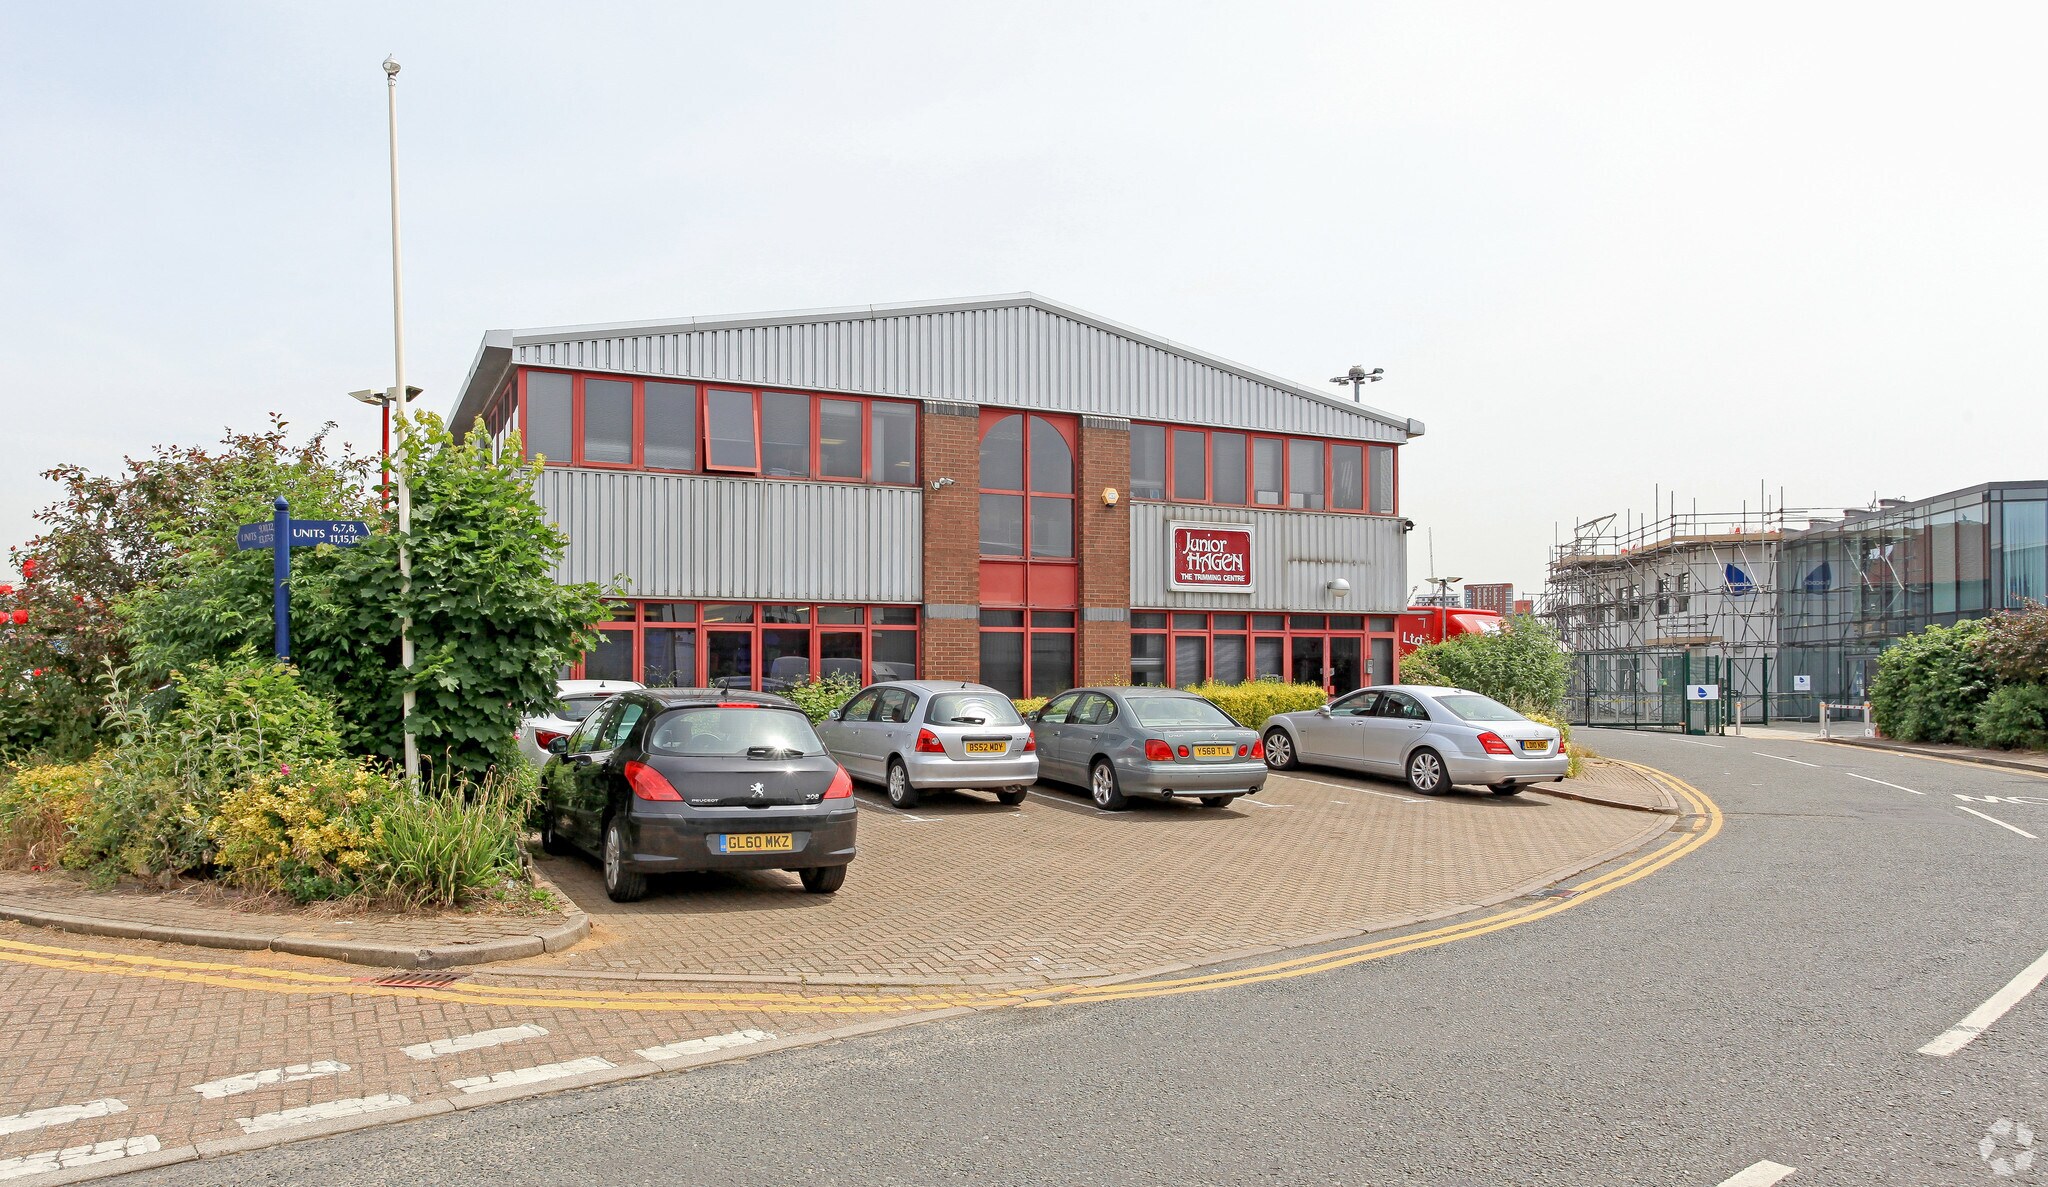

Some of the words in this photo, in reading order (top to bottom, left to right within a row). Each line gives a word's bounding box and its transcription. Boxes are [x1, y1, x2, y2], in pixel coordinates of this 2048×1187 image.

[293, 529, 325, 538] UNITS
[332, 524, 357, 534] 6,7,8,
[241, 532, 257, 542] UNITS
[1182, 531, 1227, 554] Junior
[1187, 552, 1243, 573] HAGEN
[1181, 573, 1193, 581] THE
[1194, 573, 1221, 581] TRIMMING
[1223, 574, 1246, 582] CENTRE
[1403, 631, 1423, 645] Ltd
[1197, 747, 1215, 755] Y568
[1217, 747, 1231, 755] TLA
[728, 836, 762, 849] GL60
[765, 835, 790, 848] MKZ
